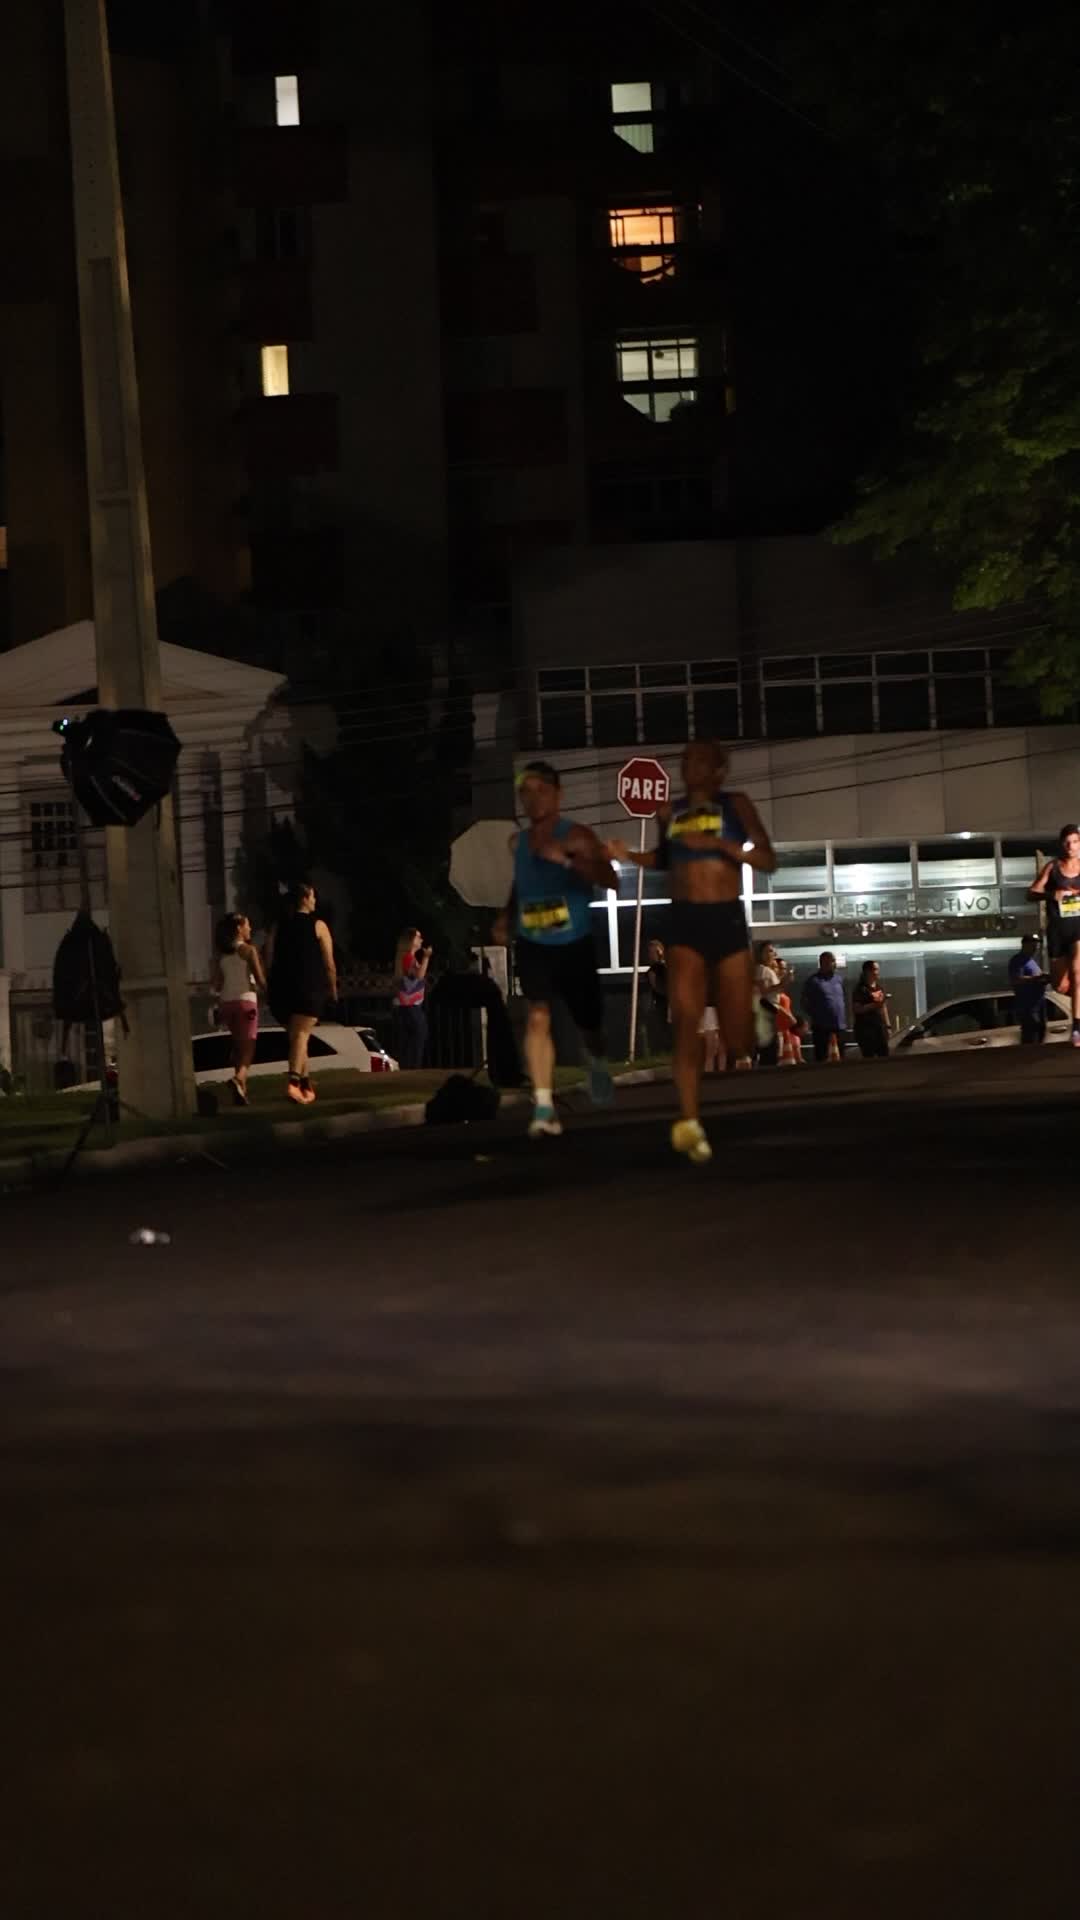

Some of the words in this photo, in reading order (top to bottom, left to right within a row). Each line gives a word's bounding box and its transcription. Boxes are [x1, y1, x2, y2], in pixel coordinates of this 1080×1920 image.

[621, 777, 666, 801] PARE
[790, 903, 869, 920] CENER
[880, 896, 991, 916] EEUTIVO
